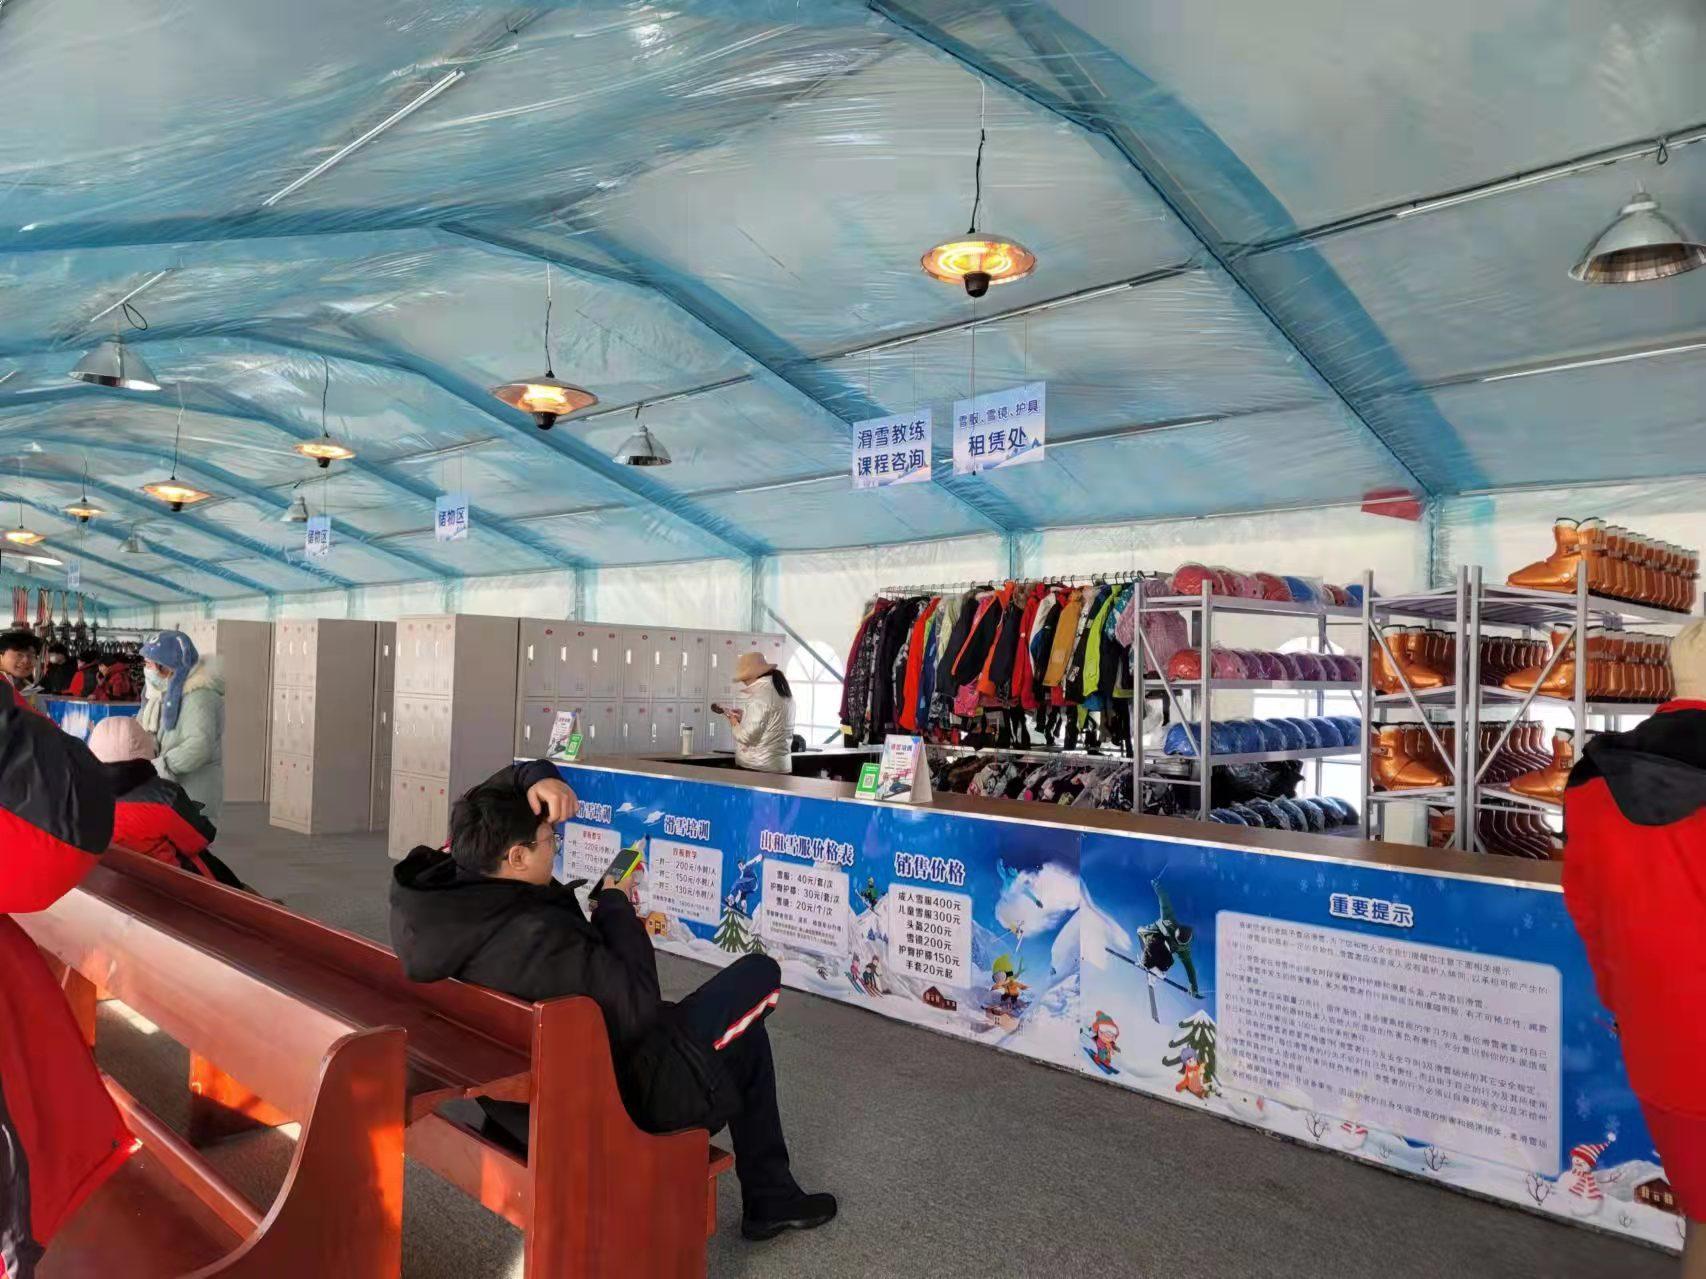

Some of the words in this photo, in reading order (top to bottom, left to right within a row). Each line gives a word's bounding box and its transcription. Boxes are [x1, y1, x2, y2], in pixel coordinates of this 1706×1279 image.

[858, 420, 925, 449] 滑雪教练
[968, 426, 1026, 457] 租赁处
[857, 449, 924, 477] 课程咨询
[664, 815, 710, 841] 滑雪培训
[895, 852, 965, 886] 销售价格
[897, 892, 961, 911] 成人雪服400元
[1330, 893, 1414, 927] 重要提示
[898, 904, 961, 925] 儿童雪服300元
[906, 919, 952, 937] 头盔200元
[906, 933, 952, 952] 雪镜200元
[898, 945, 961, 967] 护臀护膝150元
[905, 960, 953, 979] 手套20元起
